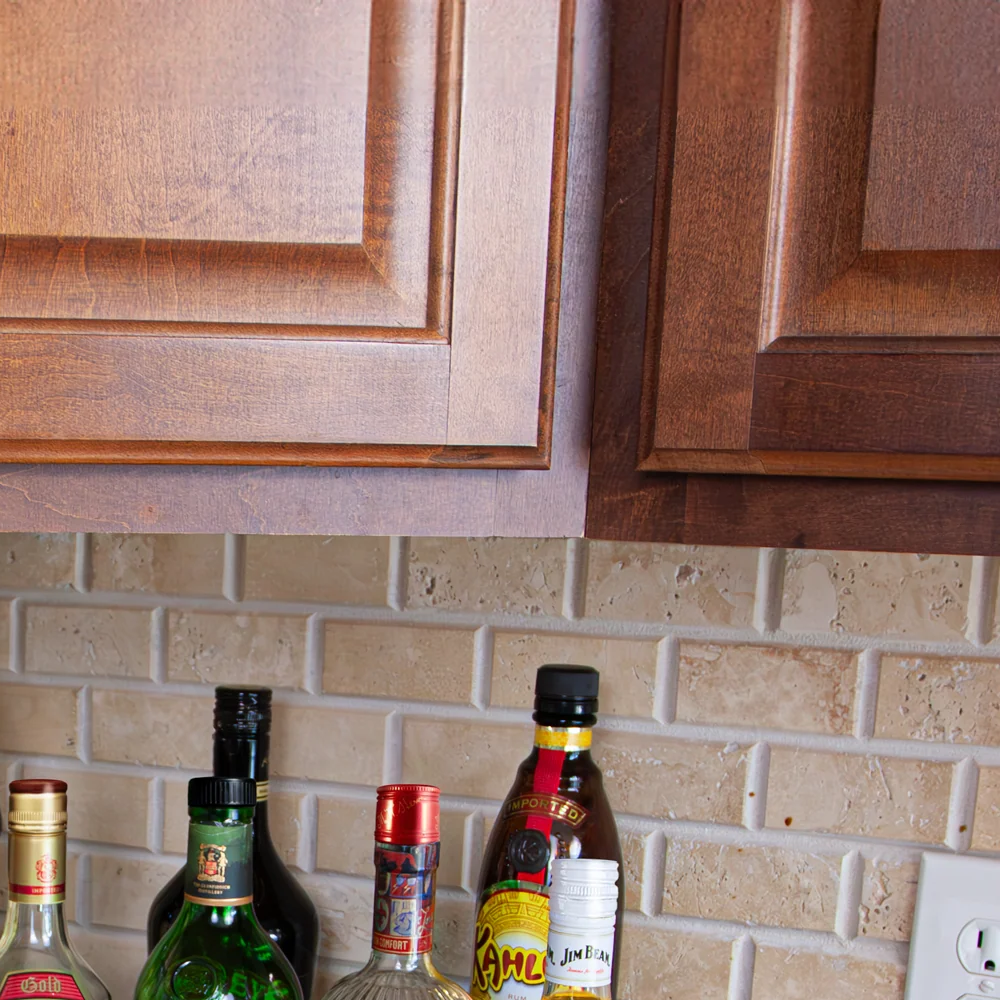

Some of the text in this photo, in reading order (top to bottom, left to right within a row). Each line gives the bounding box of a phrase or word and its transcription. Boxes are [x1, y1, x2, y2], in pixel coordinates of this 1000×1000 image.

[508, 798, 579, 820] IMPORTED
[380, 938, 408, 950] COMFORT
[476, 926, 546, 987] KAHL
[560, 945, 611, 966] JIM BEAM
[21, 975, 62, 995] Gold
